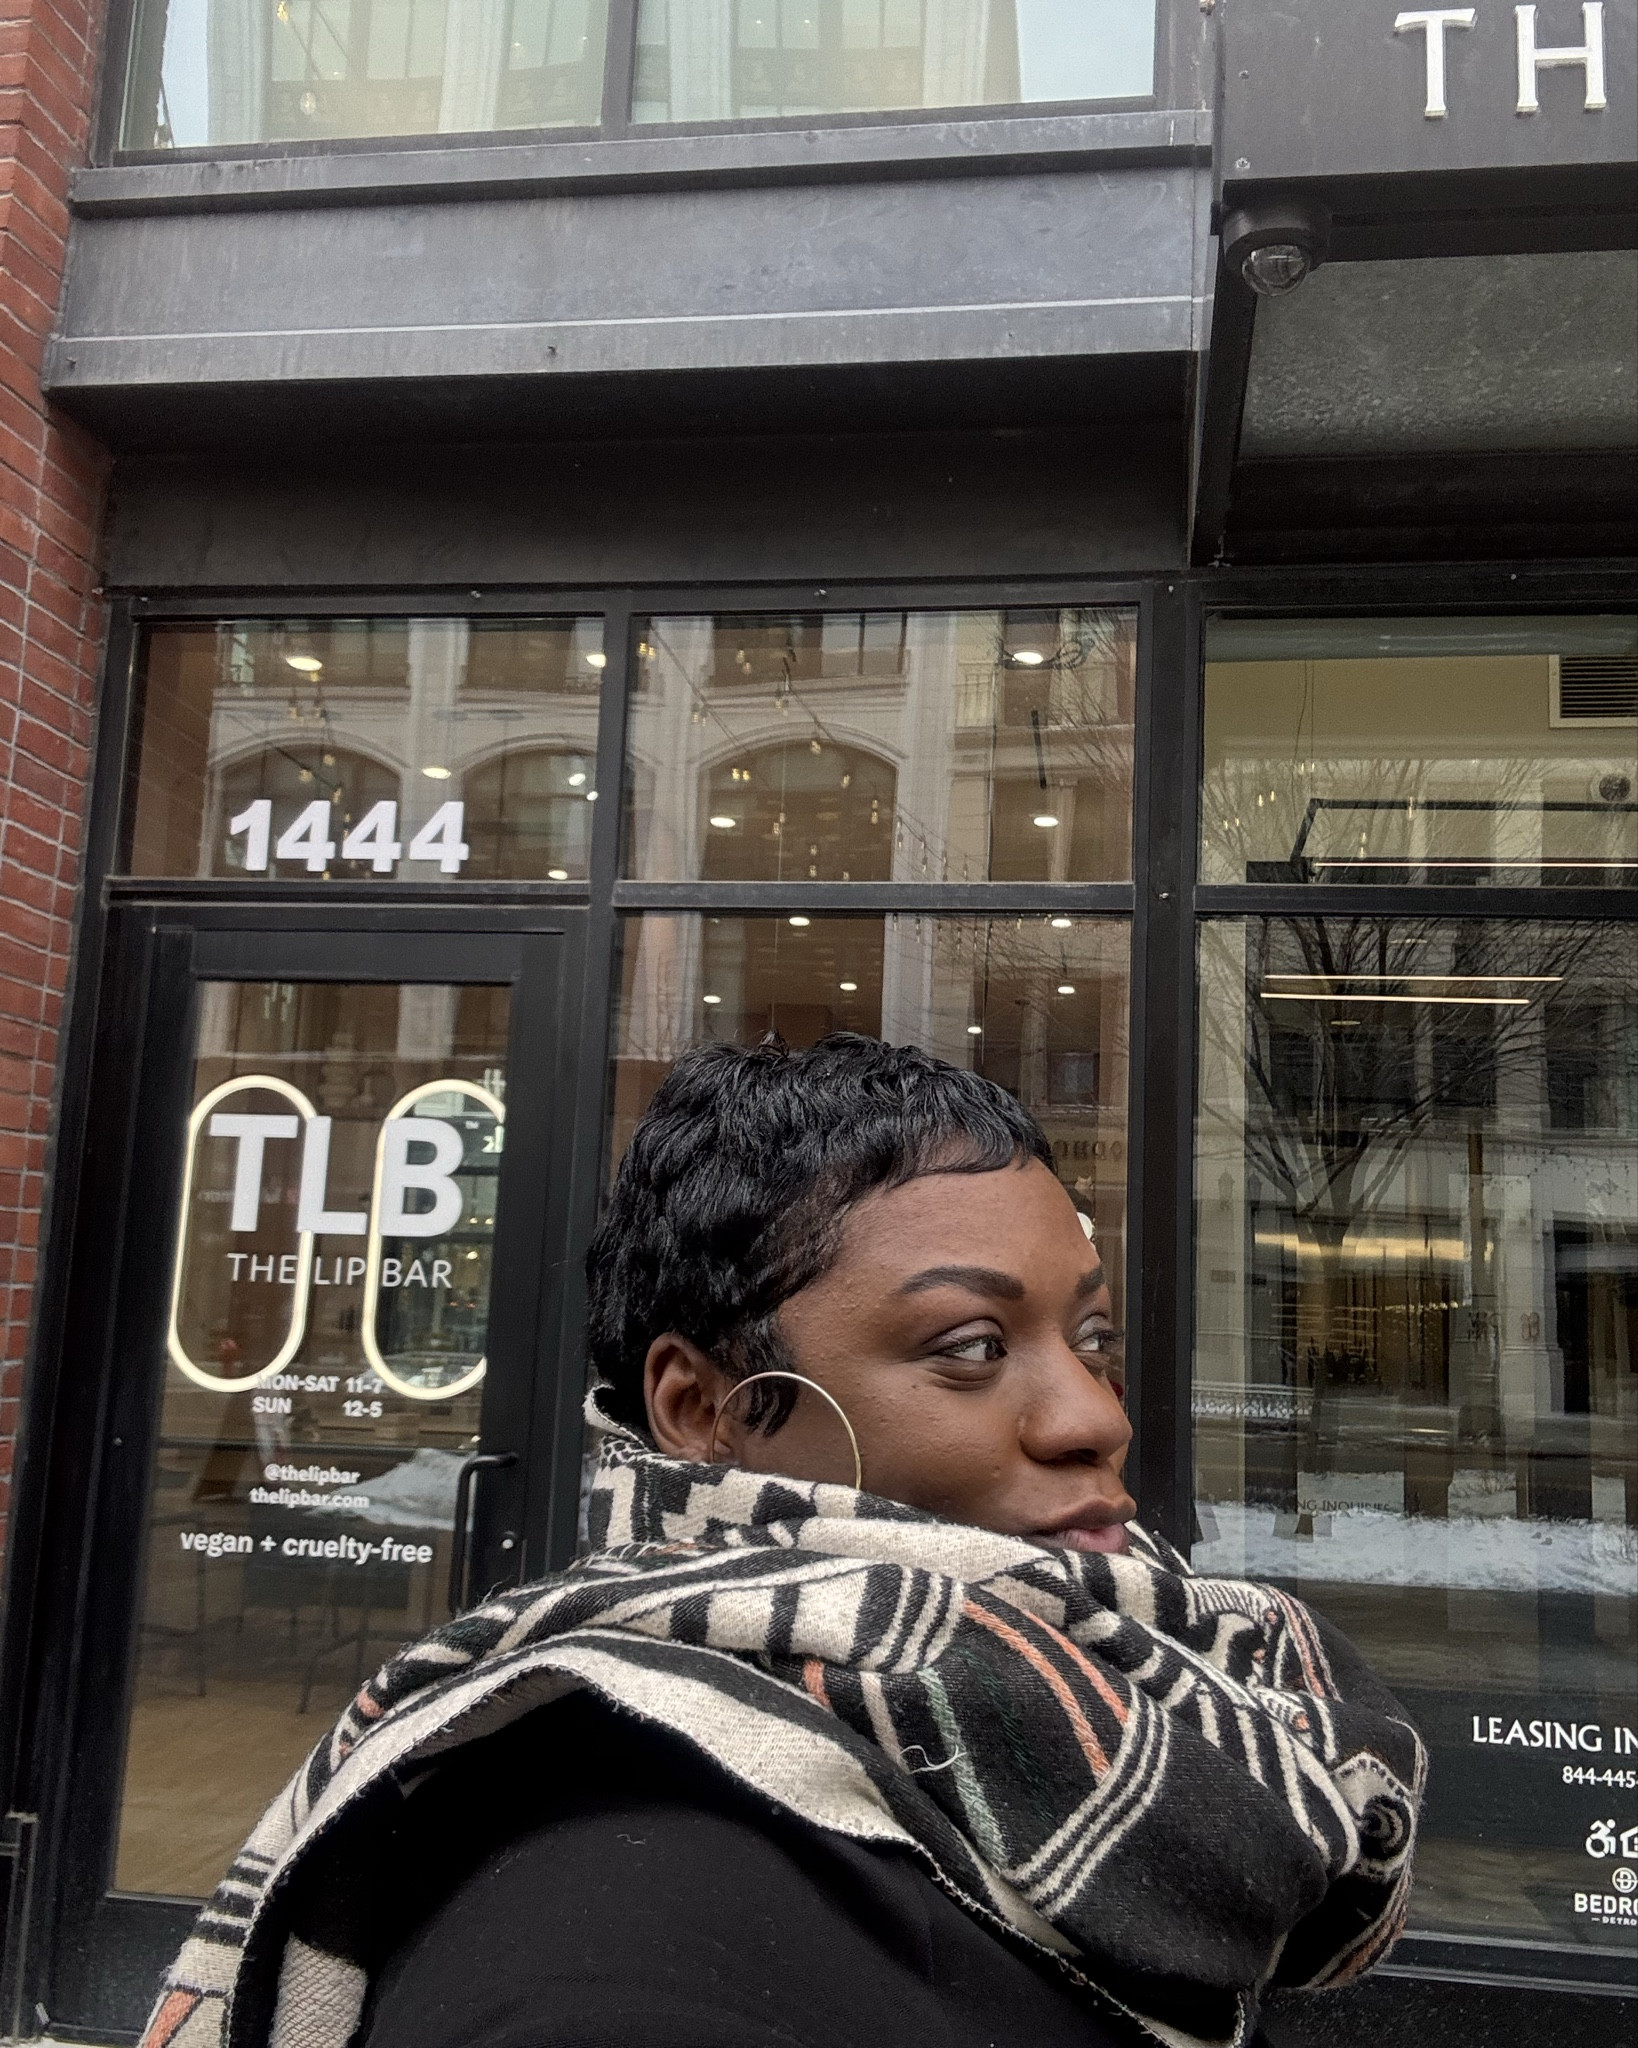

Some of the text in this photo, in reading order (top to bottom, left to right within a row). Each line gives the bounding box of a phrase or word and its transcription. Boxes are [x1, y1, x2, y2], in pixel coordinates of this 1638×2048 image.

[1394, 2, 1608, 118] TH
[230, 799, 470, 873] 1444
[209, 1113, 464, 1237] TLB
[226, 1252, 453, 1289] THE LIP BAR
[257, 1374, 383, 1394] MON-SAT 11-7
[251, 1395, 383, 1418] SUN 12-5
[264, 1463, 361, 1487] @thelipbar
[248, 1486, 371, 1509] thelipbar.com
[179, 1531, 254, 1558] vegan
[282, 1533, 434, 1565] cruelty-free
[1472, 1715, 1603, 1752] LEASING
